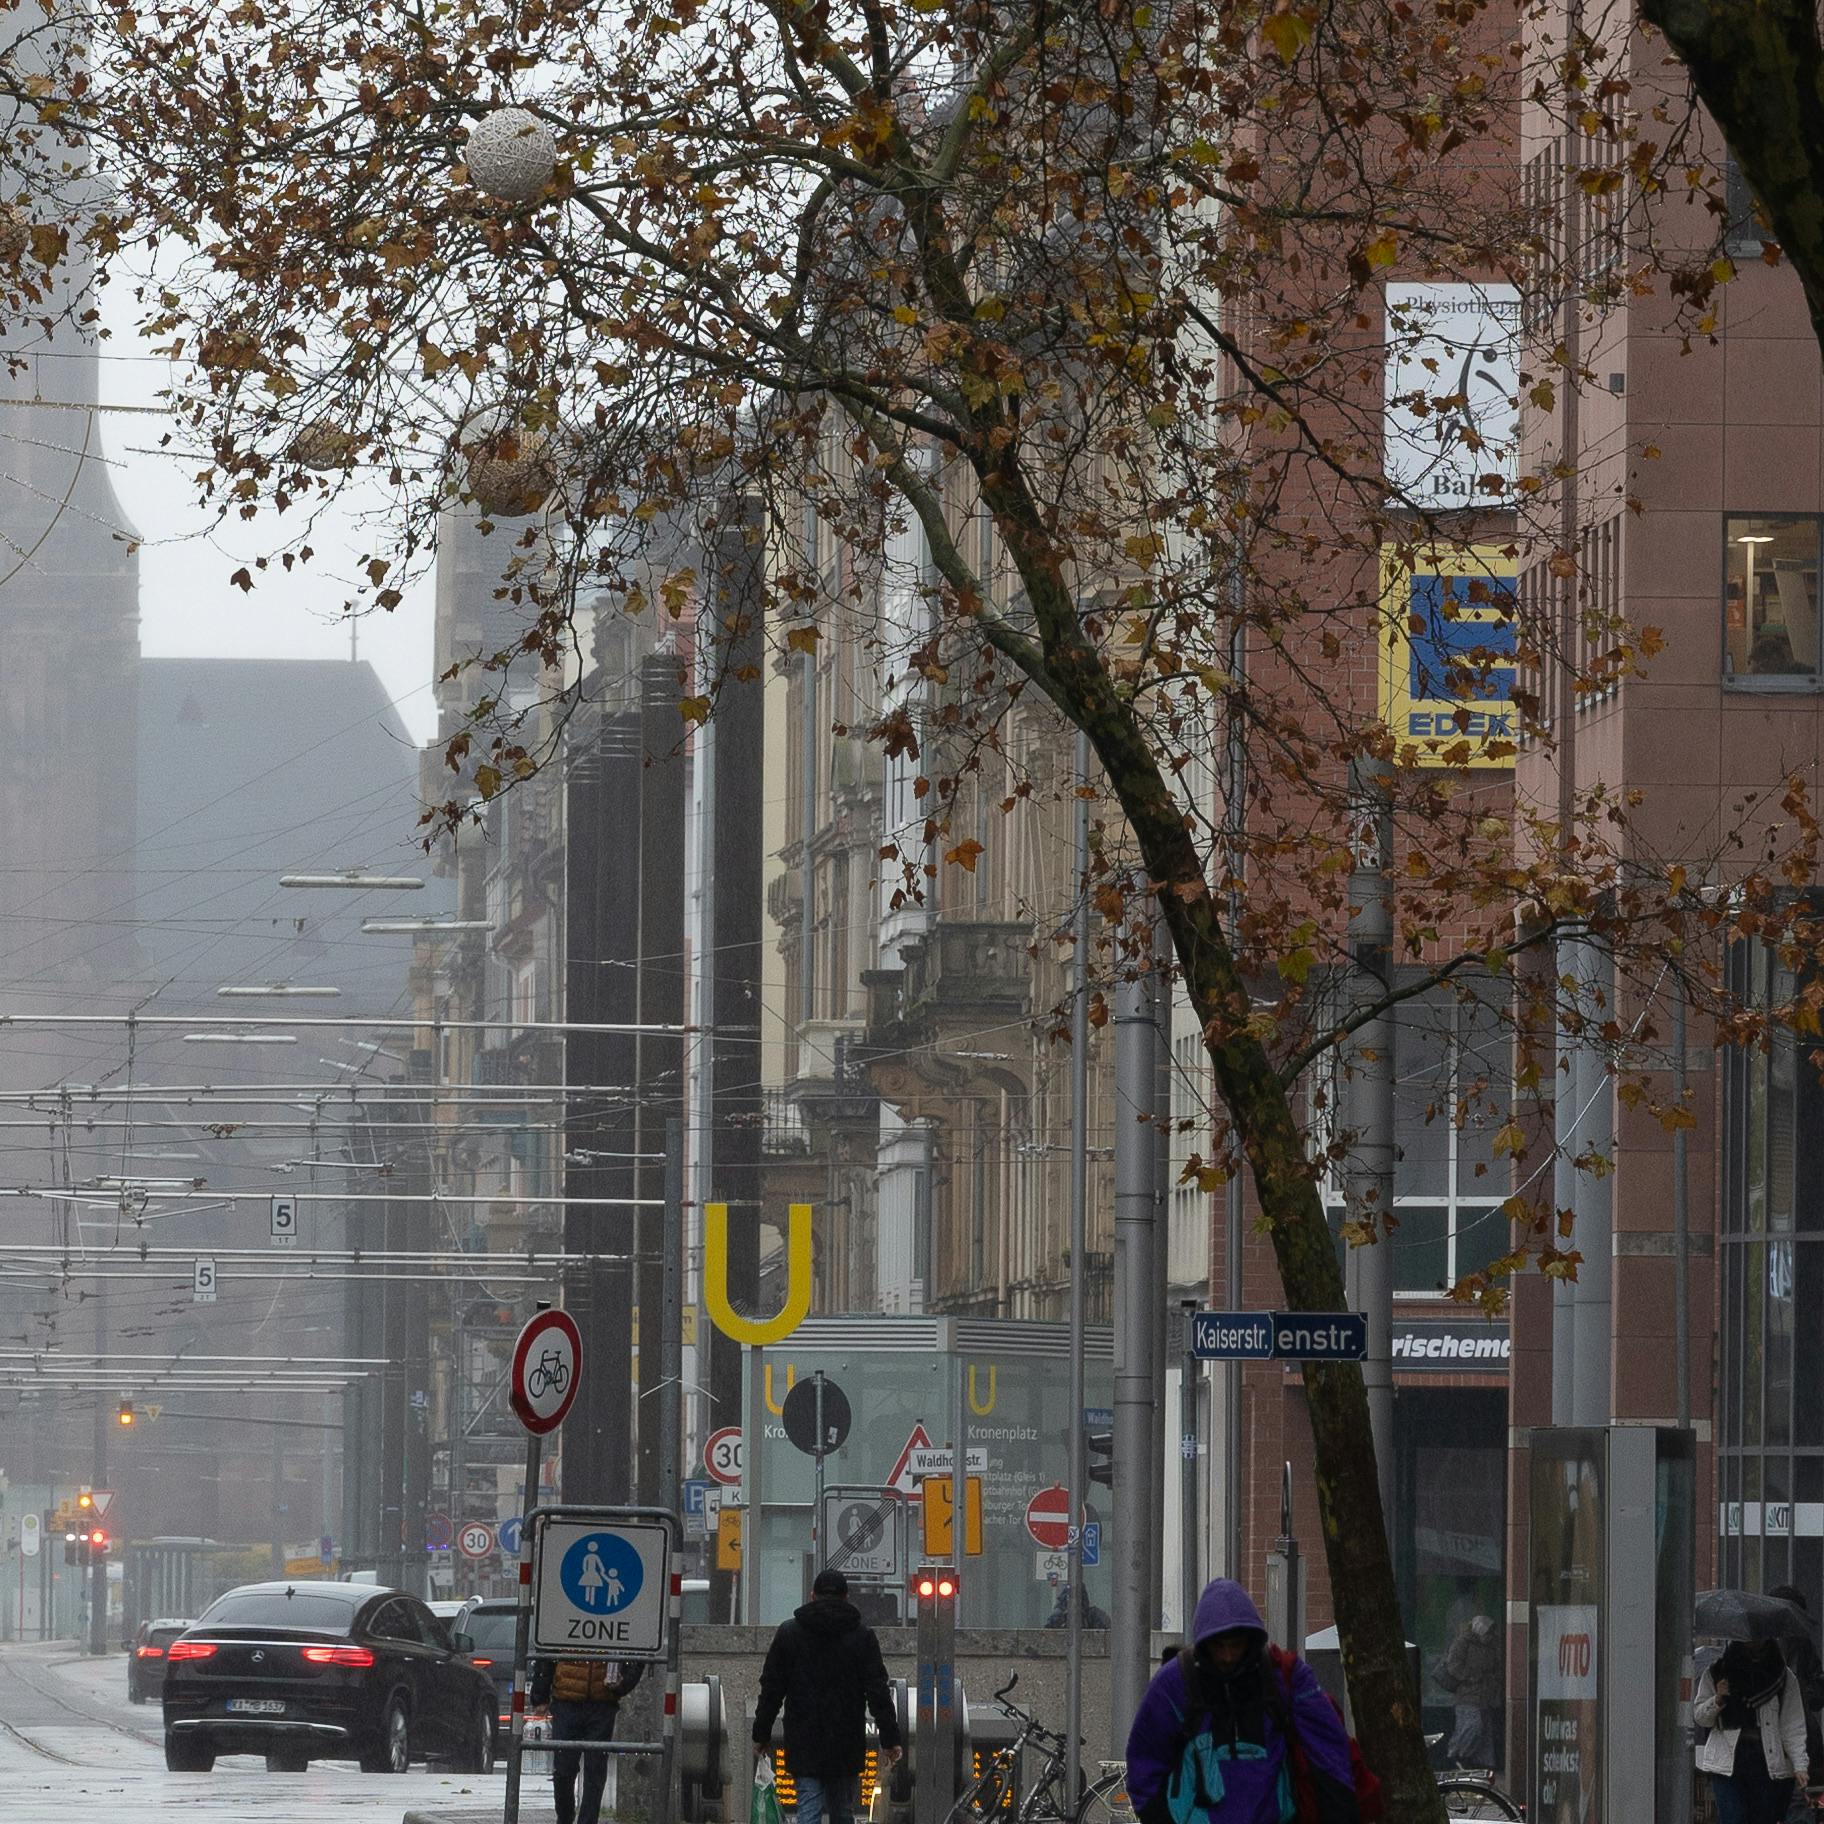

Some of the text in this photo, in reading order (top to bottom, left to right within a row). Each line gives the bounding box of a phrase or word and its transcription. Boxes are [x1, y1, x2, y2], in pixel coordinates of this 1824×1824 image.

[276, 1204, 291, 1228] 5
[198, 1266, 212, 1287] 5
[704, 1203, 812, 1346] U
[1196, 1321, 1269, 1351] Kaiserstr.
[1278, 1326, 1357, 1351] enstr.
[968, 1364, 997, 1416] U
[967, 1425, 1038, 1443] Kronenplatz
[465, 1533, 487, 1550] 30
[567, 1618, 631, 1642] ZONE
